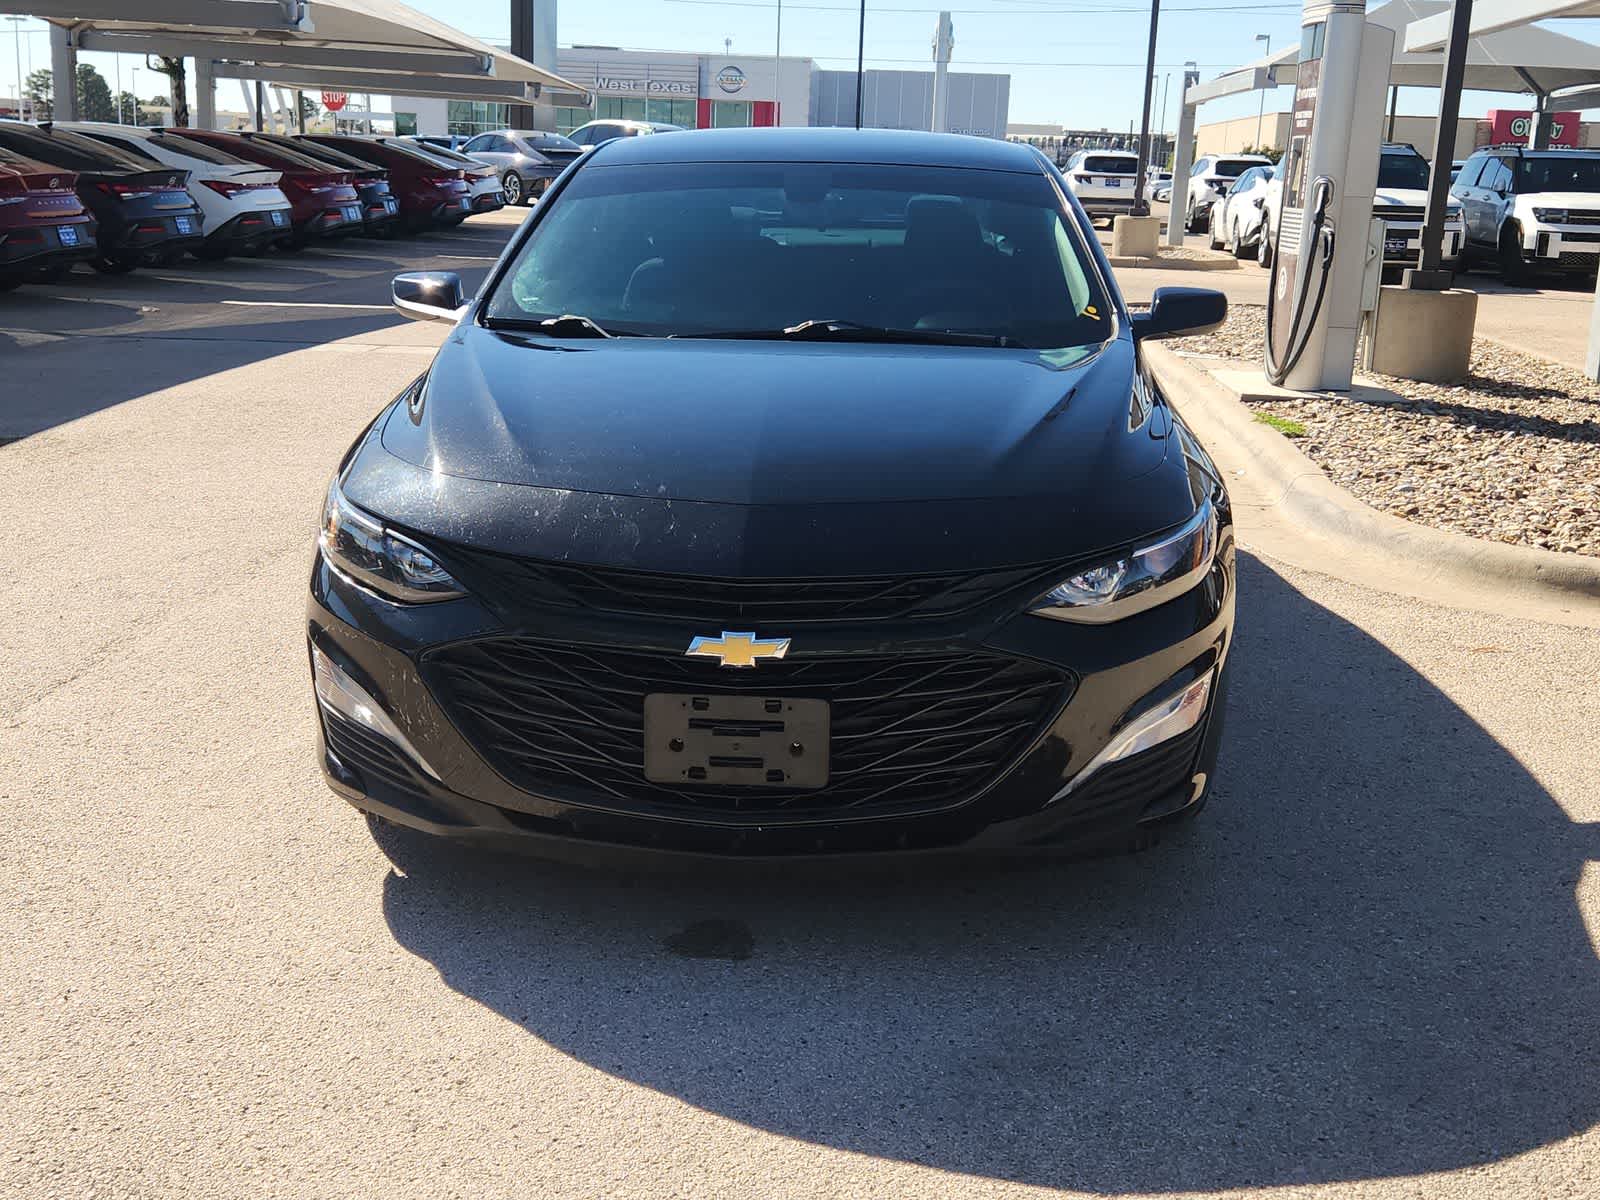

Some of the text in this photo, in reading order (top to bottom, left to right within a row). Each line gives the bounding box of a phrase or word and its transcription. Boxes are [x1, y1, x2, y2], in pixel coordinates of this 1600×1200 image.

[592, 78, 691, 94] West Texas
[323, 91, 346, 103] STOP
